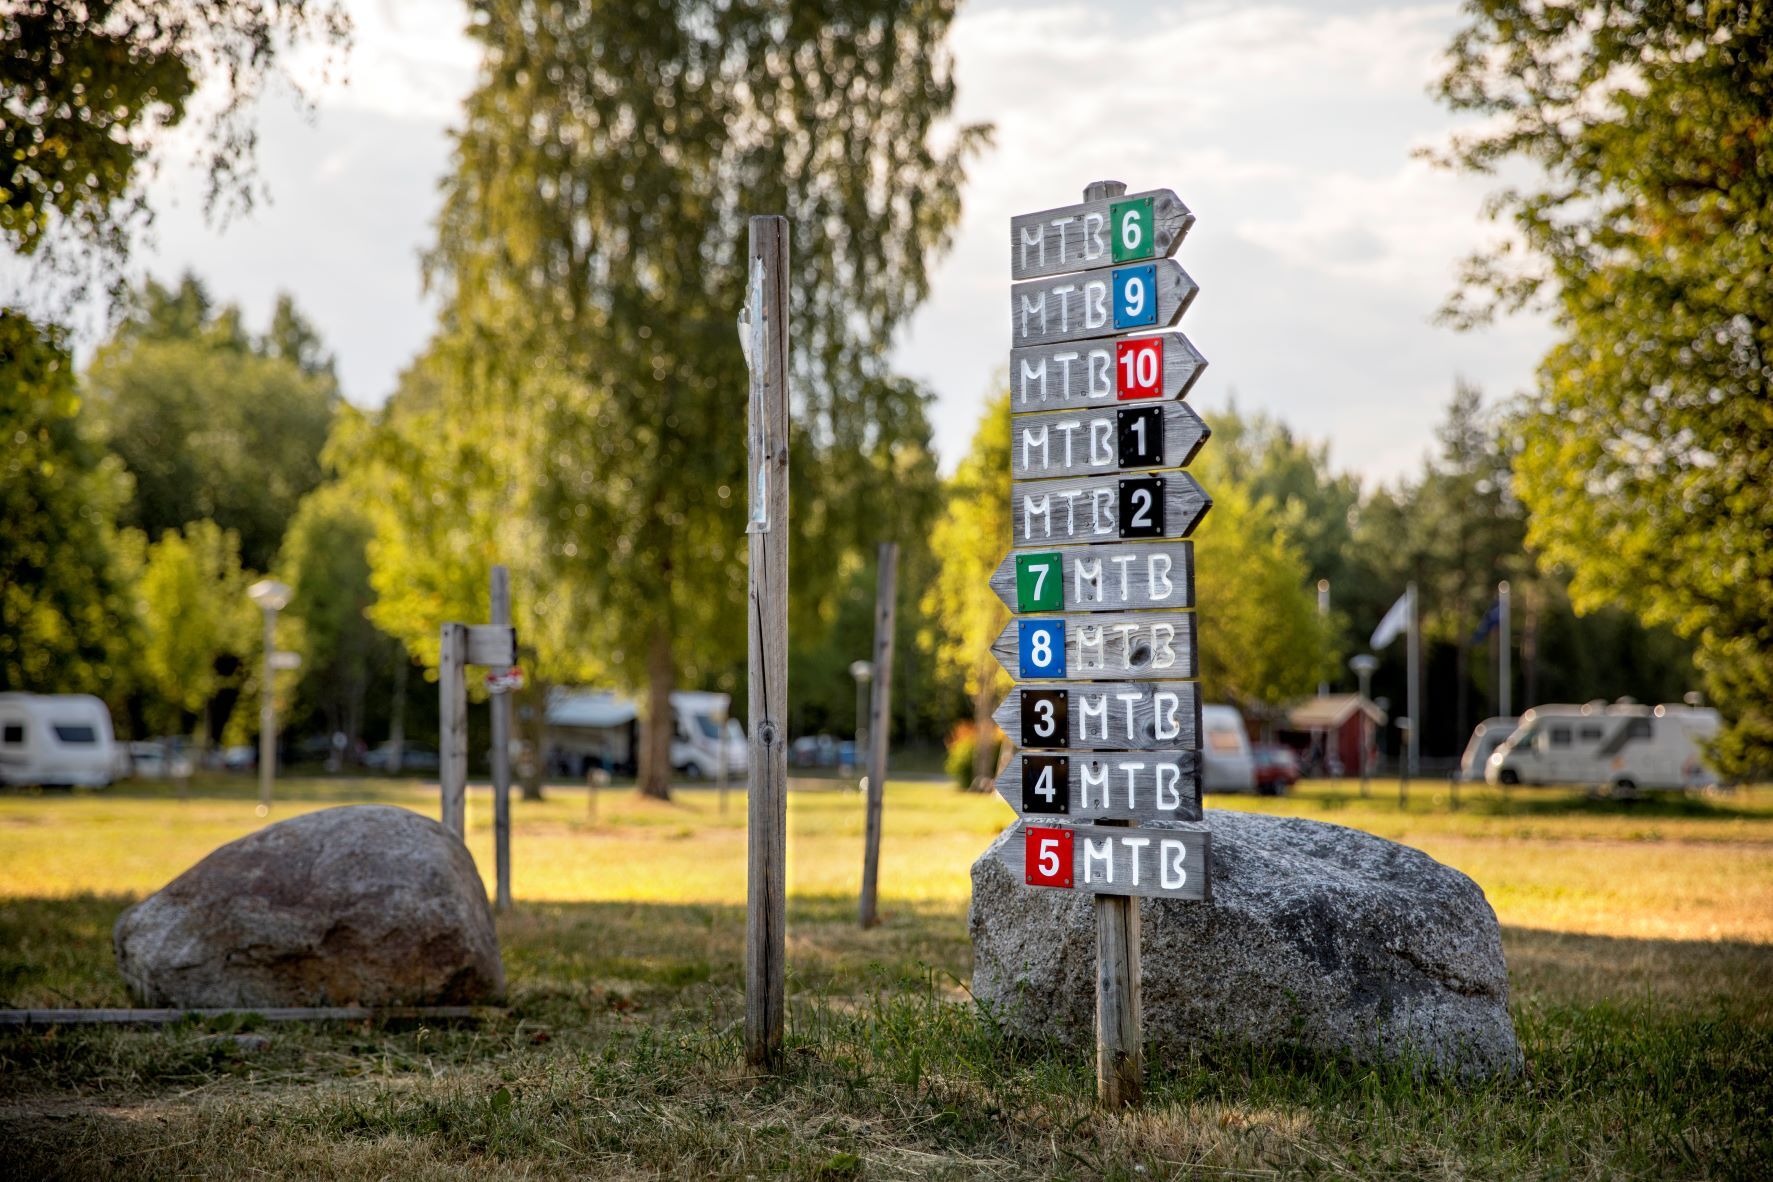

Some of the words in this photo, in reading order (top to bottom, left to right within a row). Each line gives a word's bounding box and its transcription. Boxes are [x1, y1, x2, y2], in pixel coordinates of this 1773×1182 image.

[1020, 212, 1105, 270] MTB
[1121, 210, 1142, 250] 6
[1021, 280, 1107, 338] MTB
[1124, 277, 1144, 317] 9
[1020, 348, 1111, 404] MTB
[1119, 348, 1159, 389] 10
[1022, 418, 1113, 471] MTB
[1130, 416, 1146, 456] 1
[1023, 488, 1115, 540] MTB
[1130, 489, 1152, 528] 2
[1027, 564, 1049, 601] 7
[1074, 552, 1174, 604] MTB
[1030, 629, 1053, 668] 8
[1076, 622, 1176, 670] MTB
[1033, 699, 1056, 738] 3
[1078, 692, 1180, 740] MTB
[1034, 765, 1056, 803] 4
[1080, 762, 1180, 810] MTB
[1038, 839, 1060, 877] 5
[1084, 836, 1187, 890] MTB
